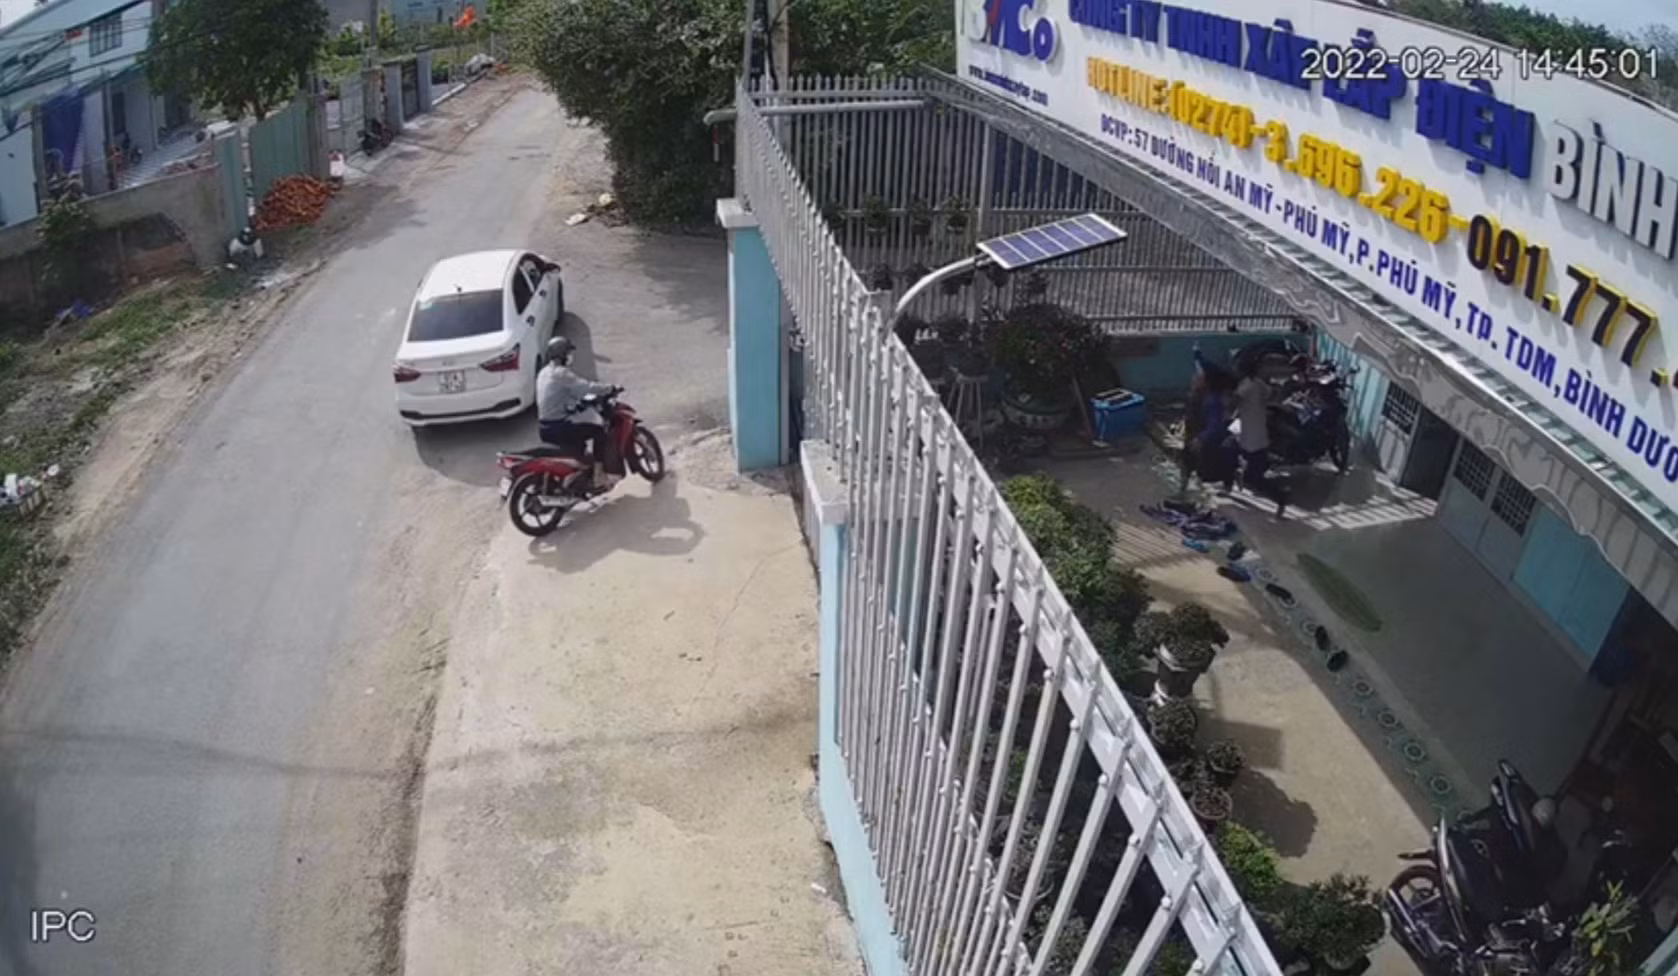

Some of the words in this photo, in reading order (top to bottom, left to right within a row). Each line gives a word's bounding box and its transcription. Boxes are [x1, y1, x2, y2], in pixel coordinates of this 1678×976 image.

[1163, 5, 1242, 69] TNHH
[1416, 76, 1535, 178] ĐIỆN
[1550, 118, 1678, 261] BÌNH
[1134, 128, 1149, 152] 57
[1224, 170, 1246, 201] AN
[1249, 181, 1273, 214] MỸ
[1563, 368, 1626, 439] BÌNH
